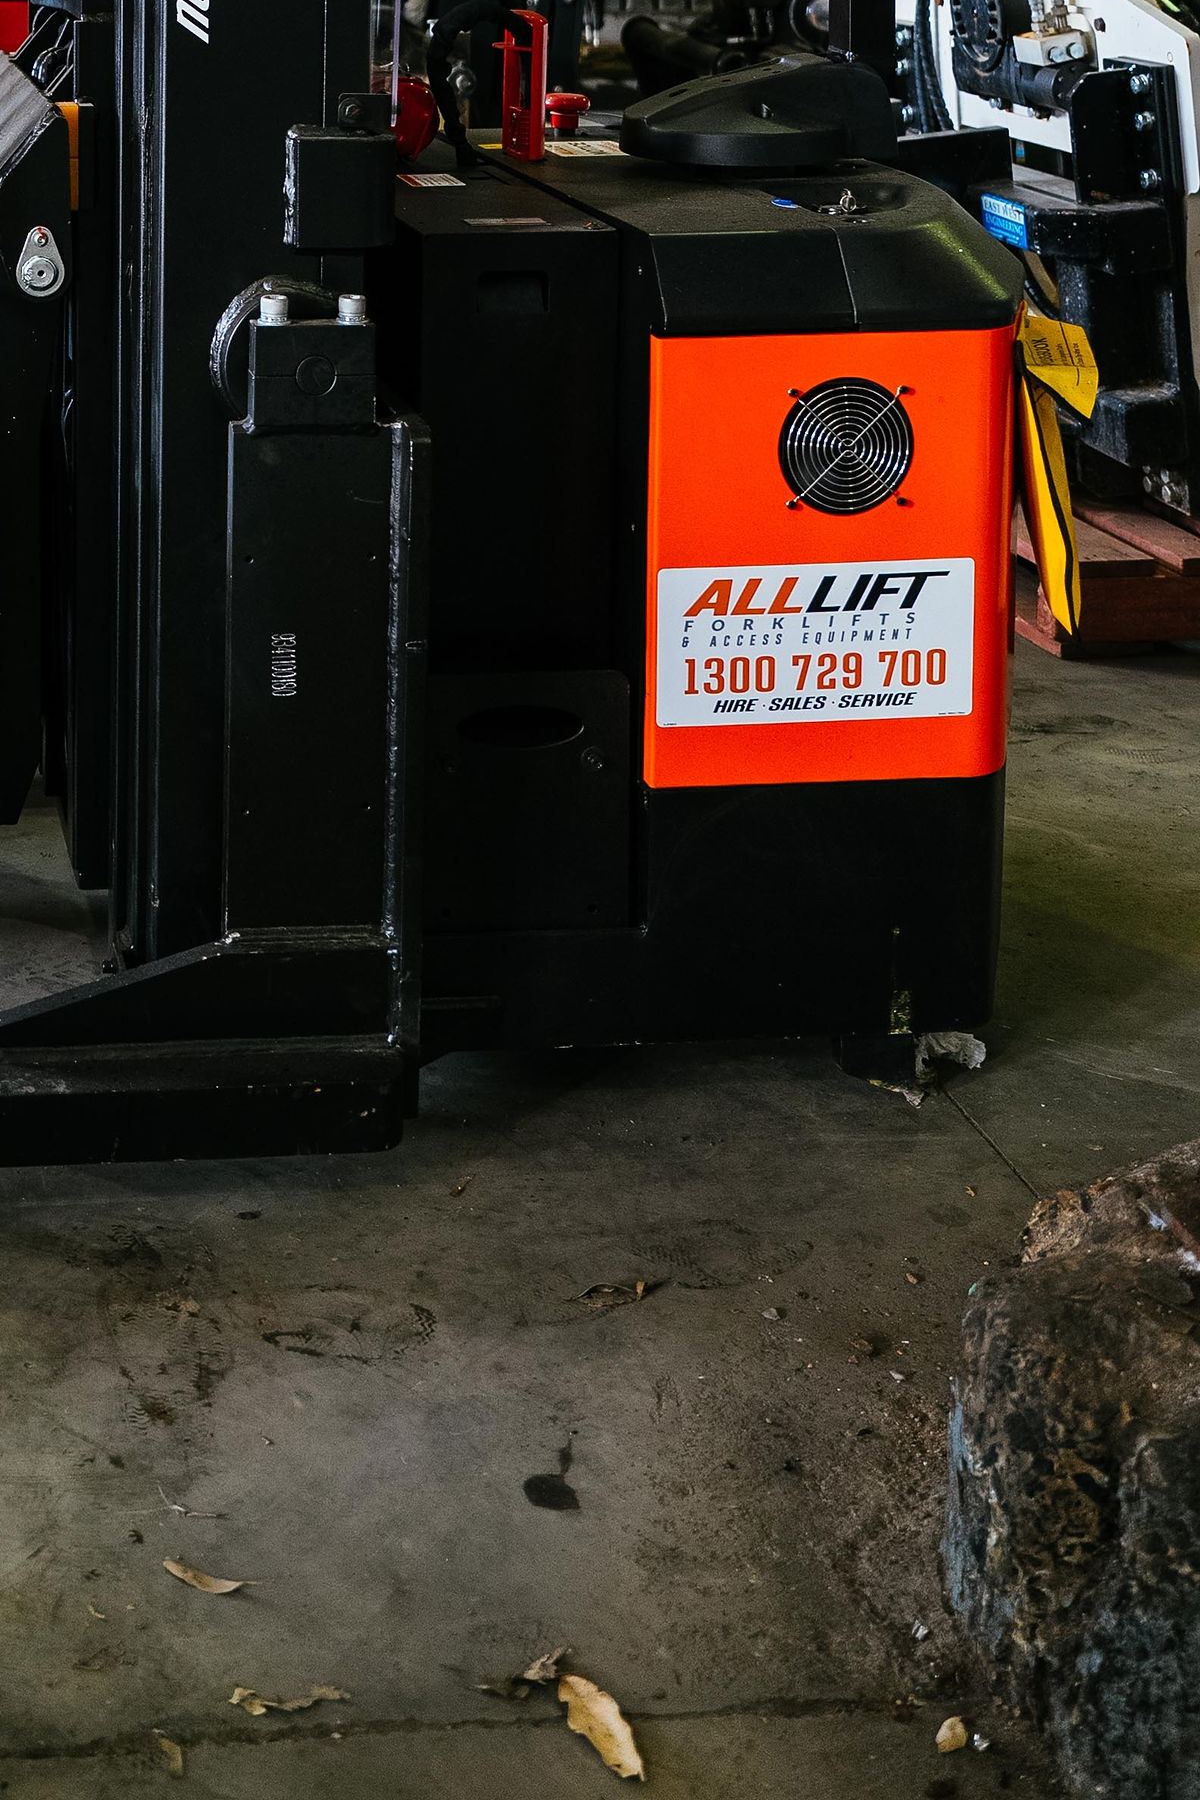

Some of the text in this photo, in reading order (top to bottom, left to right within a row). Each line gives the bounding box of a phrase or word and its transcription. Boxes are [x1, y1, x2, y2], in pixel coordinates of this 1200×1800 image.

[983, 199, 1023, 222] EAST WEST
[985, 212, 1023, 236] ENGINEERING
[682, 571, 951, 617] ALLLIFT
[684, 612, 915, 633] FORKLIFTS
[681, 628, 913, 648] & ACCESS EQUIPMENT
[684, 648, 947, 695] 1300 729 700
[712, 691, 918, 714] HIRE SALES SERVICE
